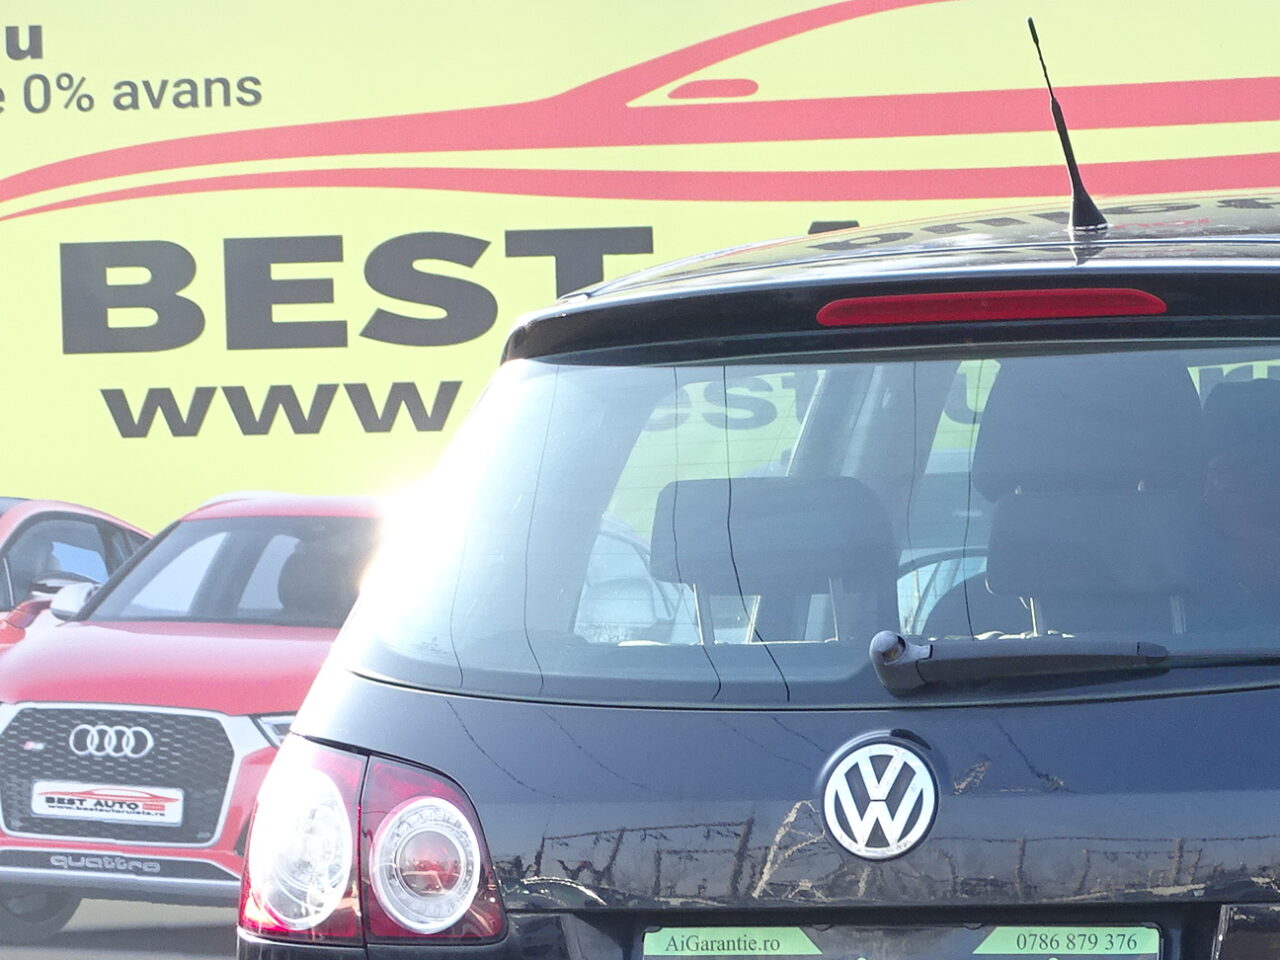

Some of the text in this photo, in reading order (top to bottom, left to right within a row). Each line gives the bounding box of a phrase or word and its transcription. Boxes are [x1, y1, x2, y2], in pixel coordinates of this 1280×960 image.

[22, 71, 95, 115] 0%
[112, 75, 262, 111] avans
[59, 226, 654, 355] BEST
[45, 795, 87, 808] BEST
[95, 799, 140, 811] AUTO
[50, 855, 161, 873] quattro
[665, 934, 781, 953] AiGarantie.ro
[1016, 931, 1138, 951] 0786 879 376
